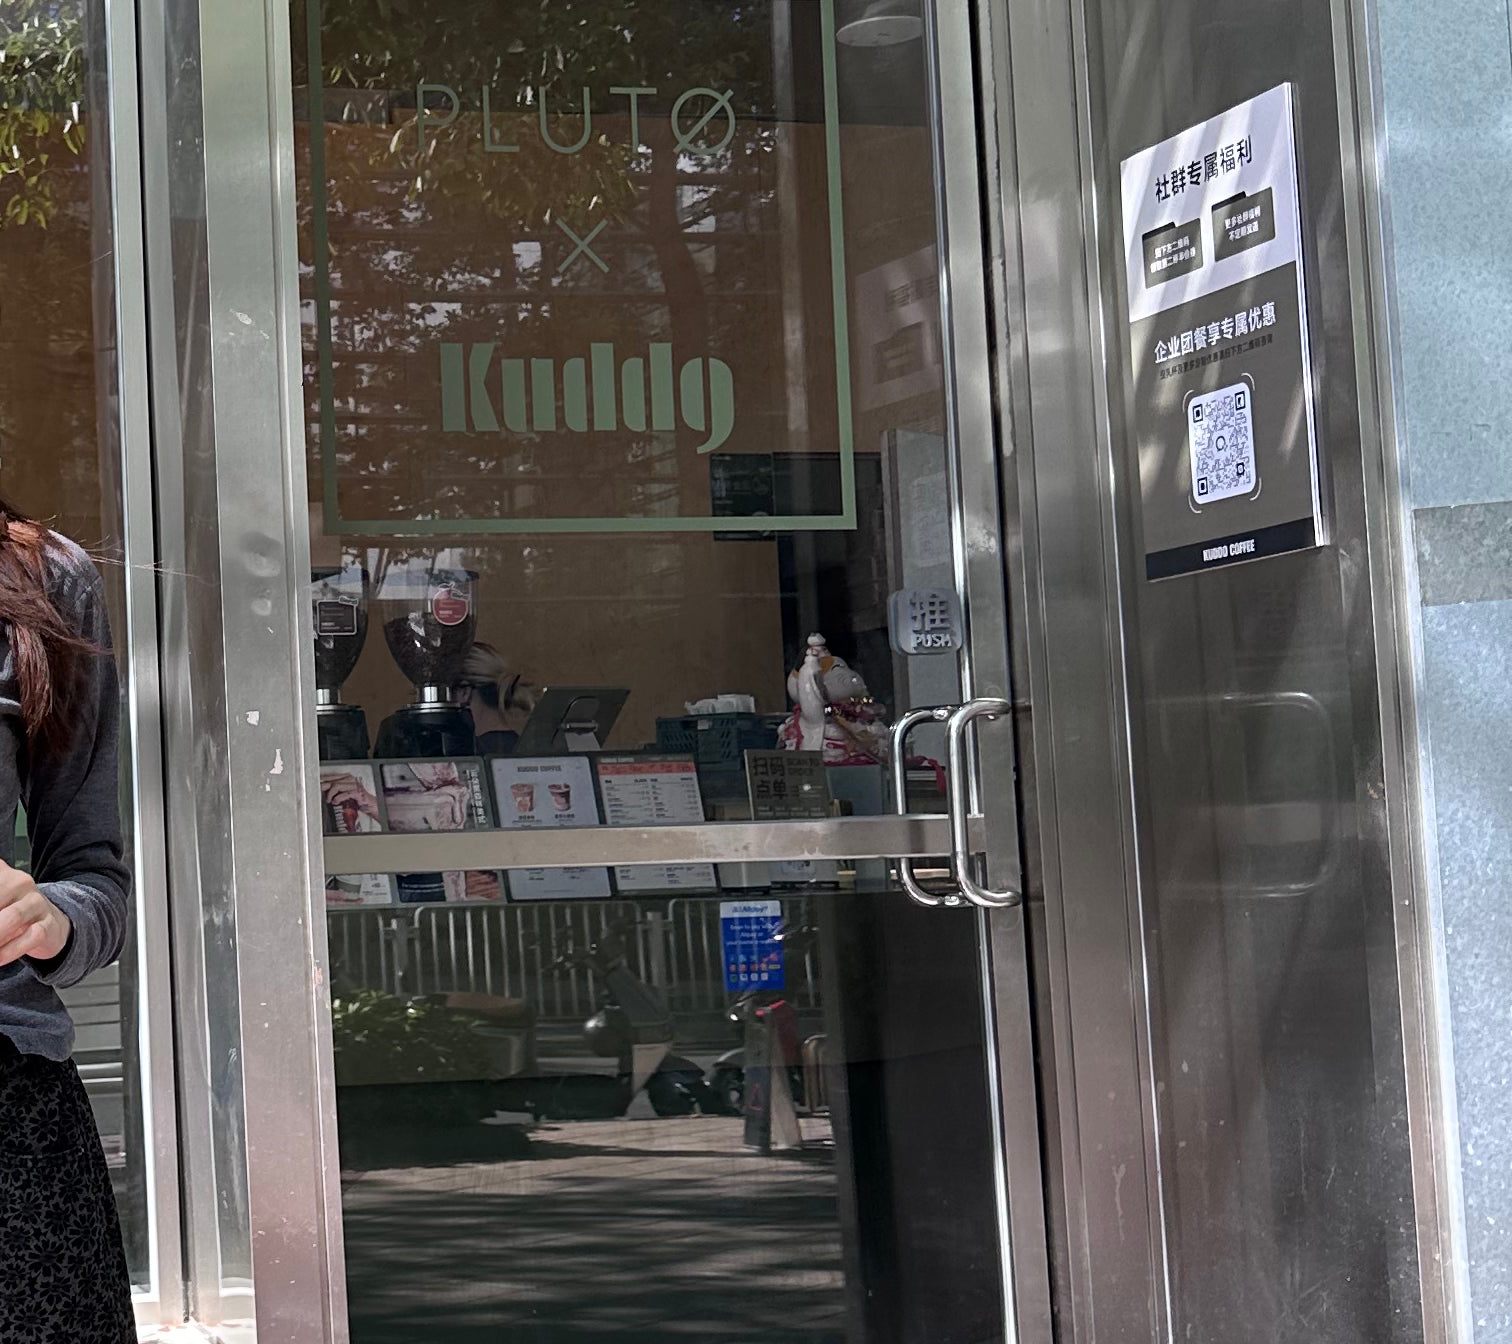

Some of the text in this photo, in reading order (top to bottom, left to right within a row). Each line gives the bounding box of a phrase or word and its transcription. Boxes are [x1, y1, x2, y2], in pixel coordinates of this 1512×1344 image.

[1155, 134, 1252, 204] 社群专属福利
[1154, 301, 1276, 364] 企业团餐享专属优惠
[910, 592, 951, 632] 推
[911, 633, 952, 649] PUSH
